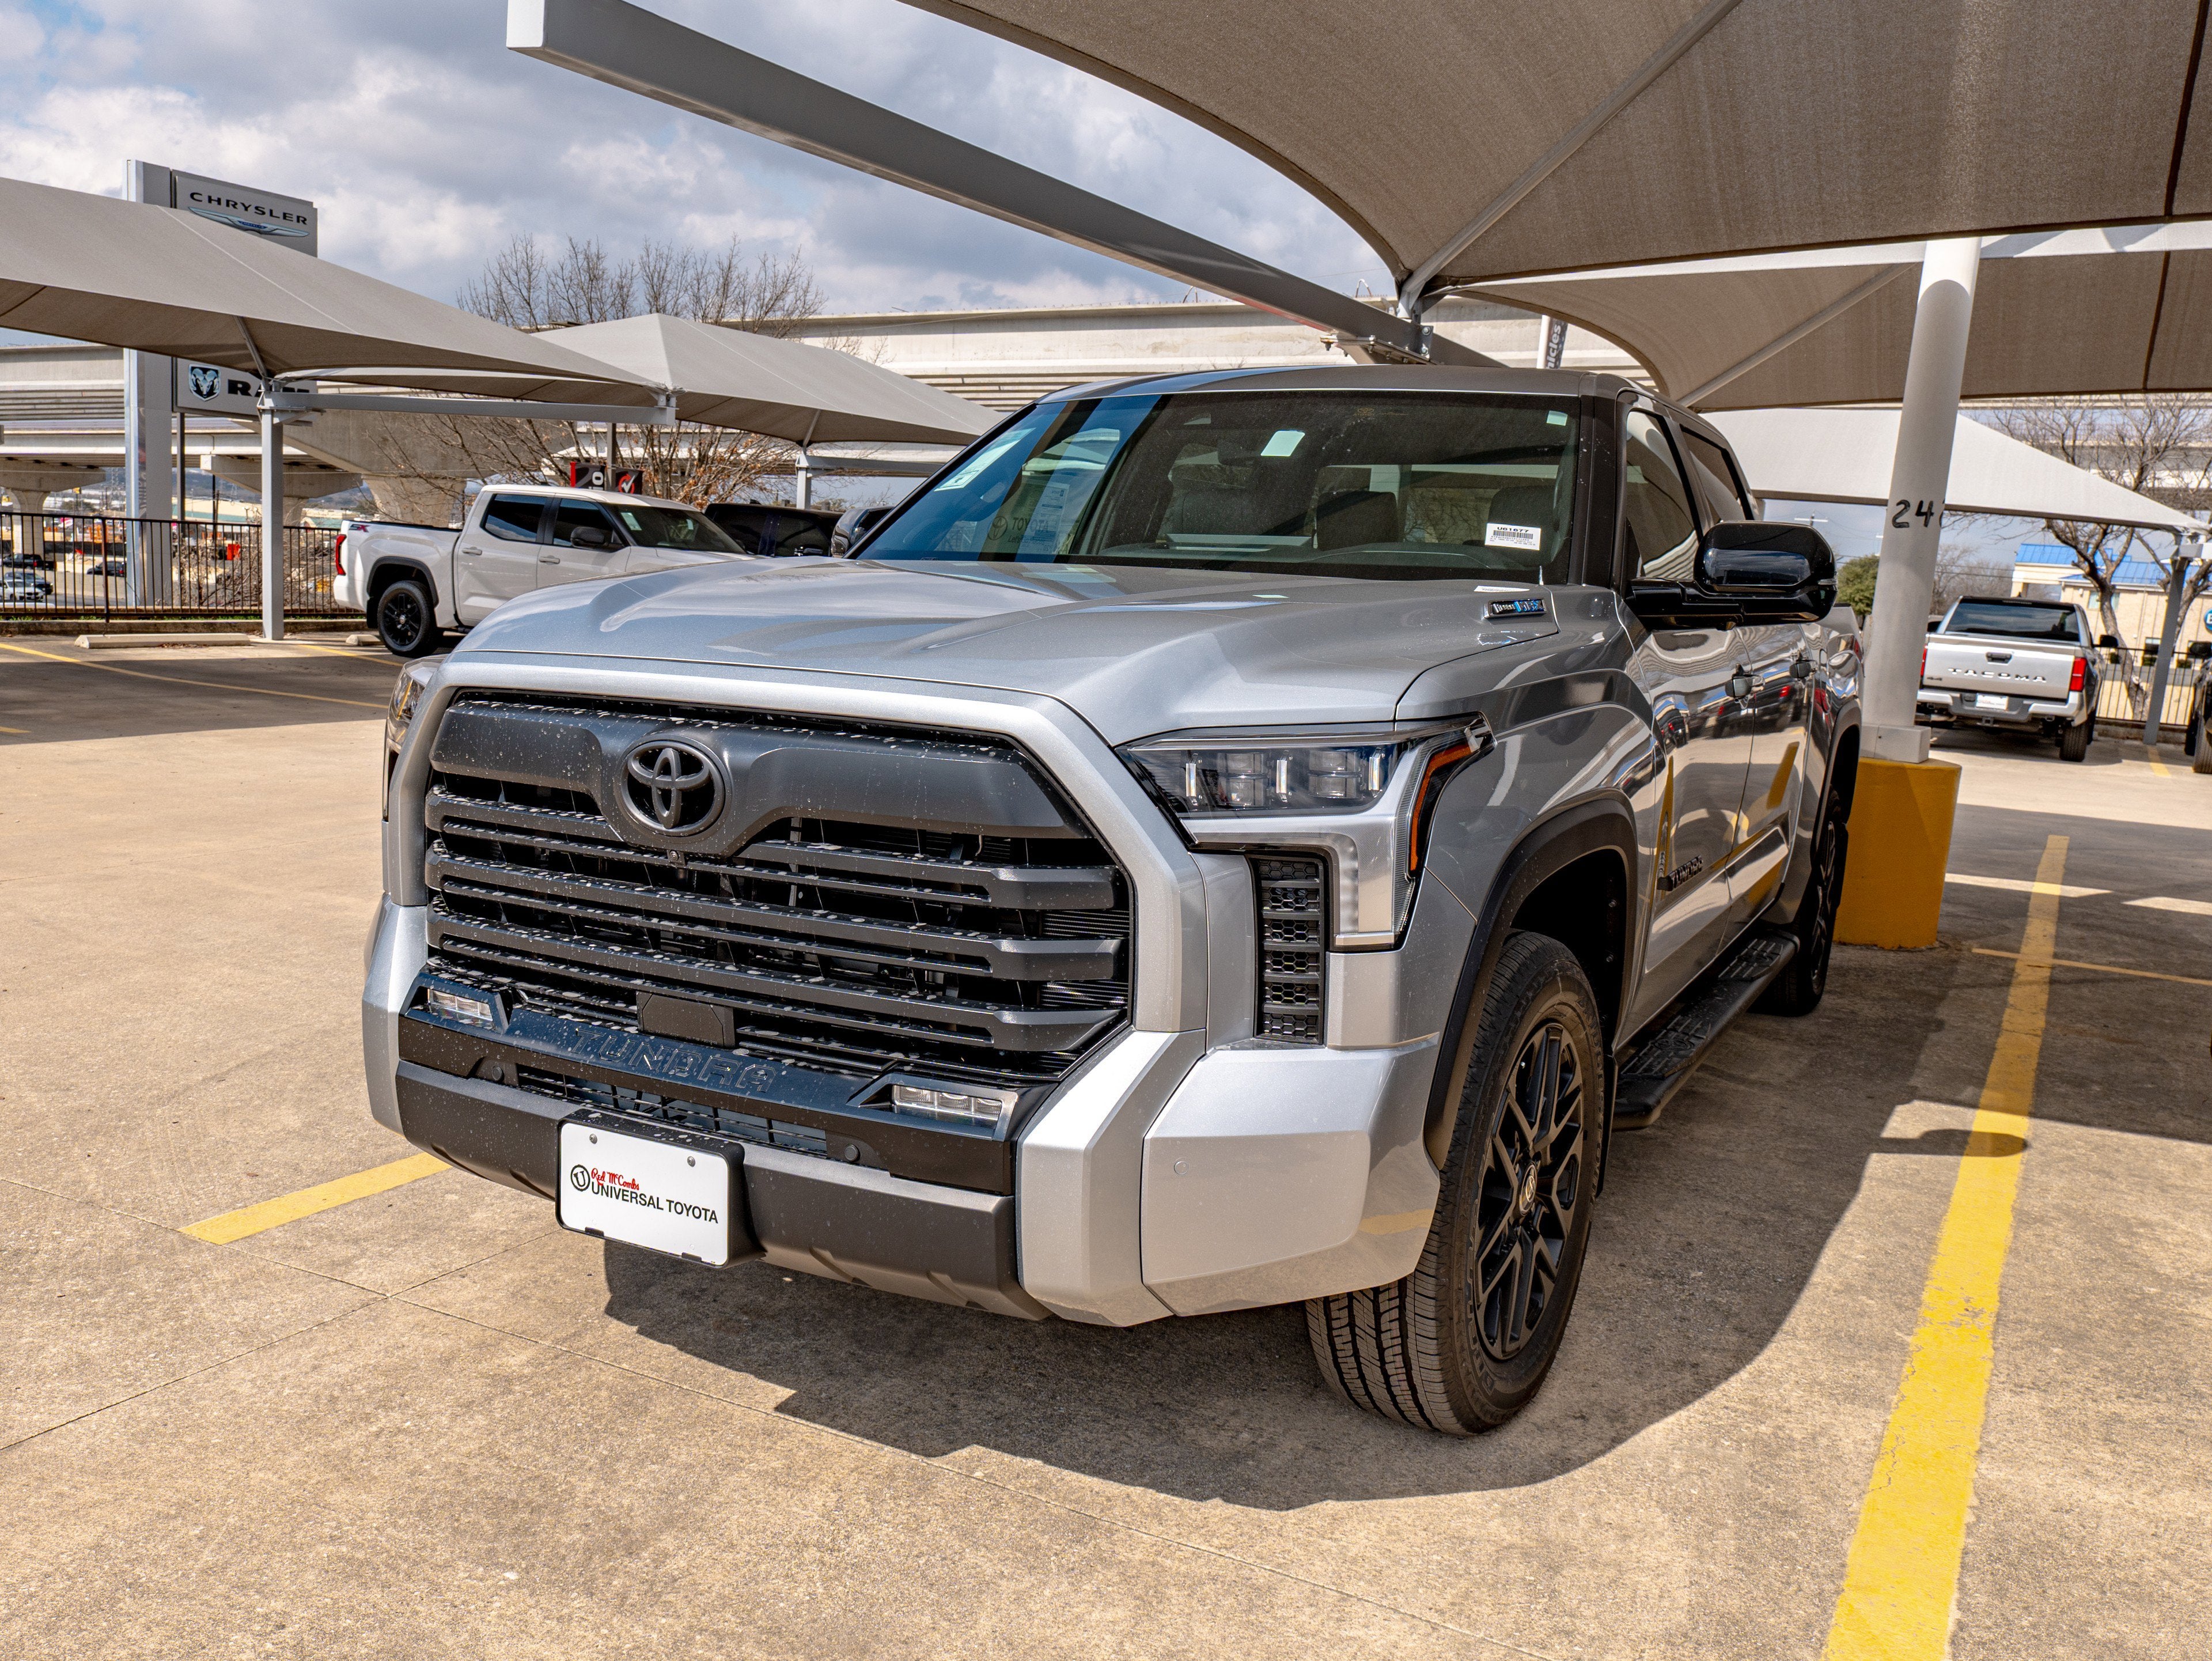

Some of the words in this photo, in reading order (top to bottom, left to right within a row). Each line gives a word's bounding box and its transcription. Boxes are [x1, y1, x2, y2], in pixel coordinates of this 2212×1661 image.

[190, 192, 308, 225] CHRYSLER
[1892, 499, 1945, 528] 24
[1948, 667, 2047, 683] TACOMA
[572, 1029, 777, 1092] TUNDRA
[591, 1168, 605, 1185] Red
[607, 1172, 639, 1190] McCombs
[592, 1182, 664, 1210] UNIVERSAL
[666, 1199, 718, 1224] TOYOTA
